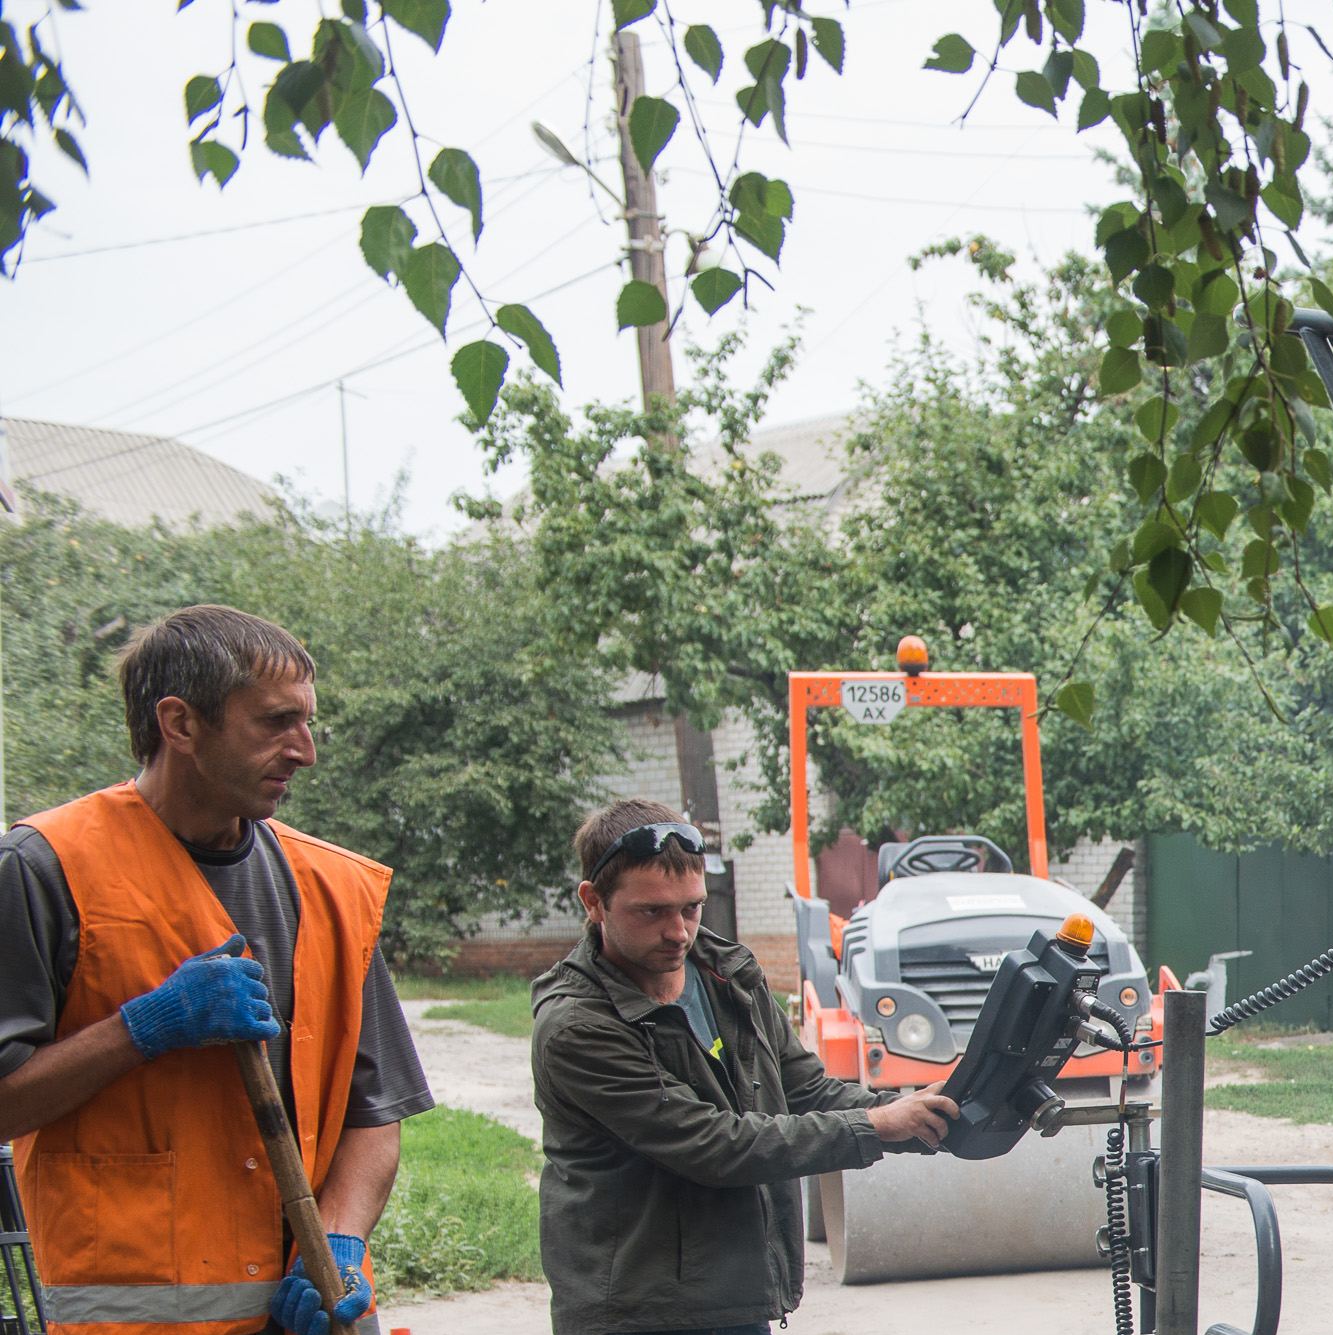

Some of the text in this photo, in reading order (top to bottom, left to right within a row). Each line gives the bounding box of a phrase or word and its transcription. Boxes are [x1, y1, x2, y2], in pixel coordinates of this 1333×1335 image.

[846, 685, 901, 703] 12586
[862, 706, 887, 720] AX
[983, 957, 1002, 968] HA
